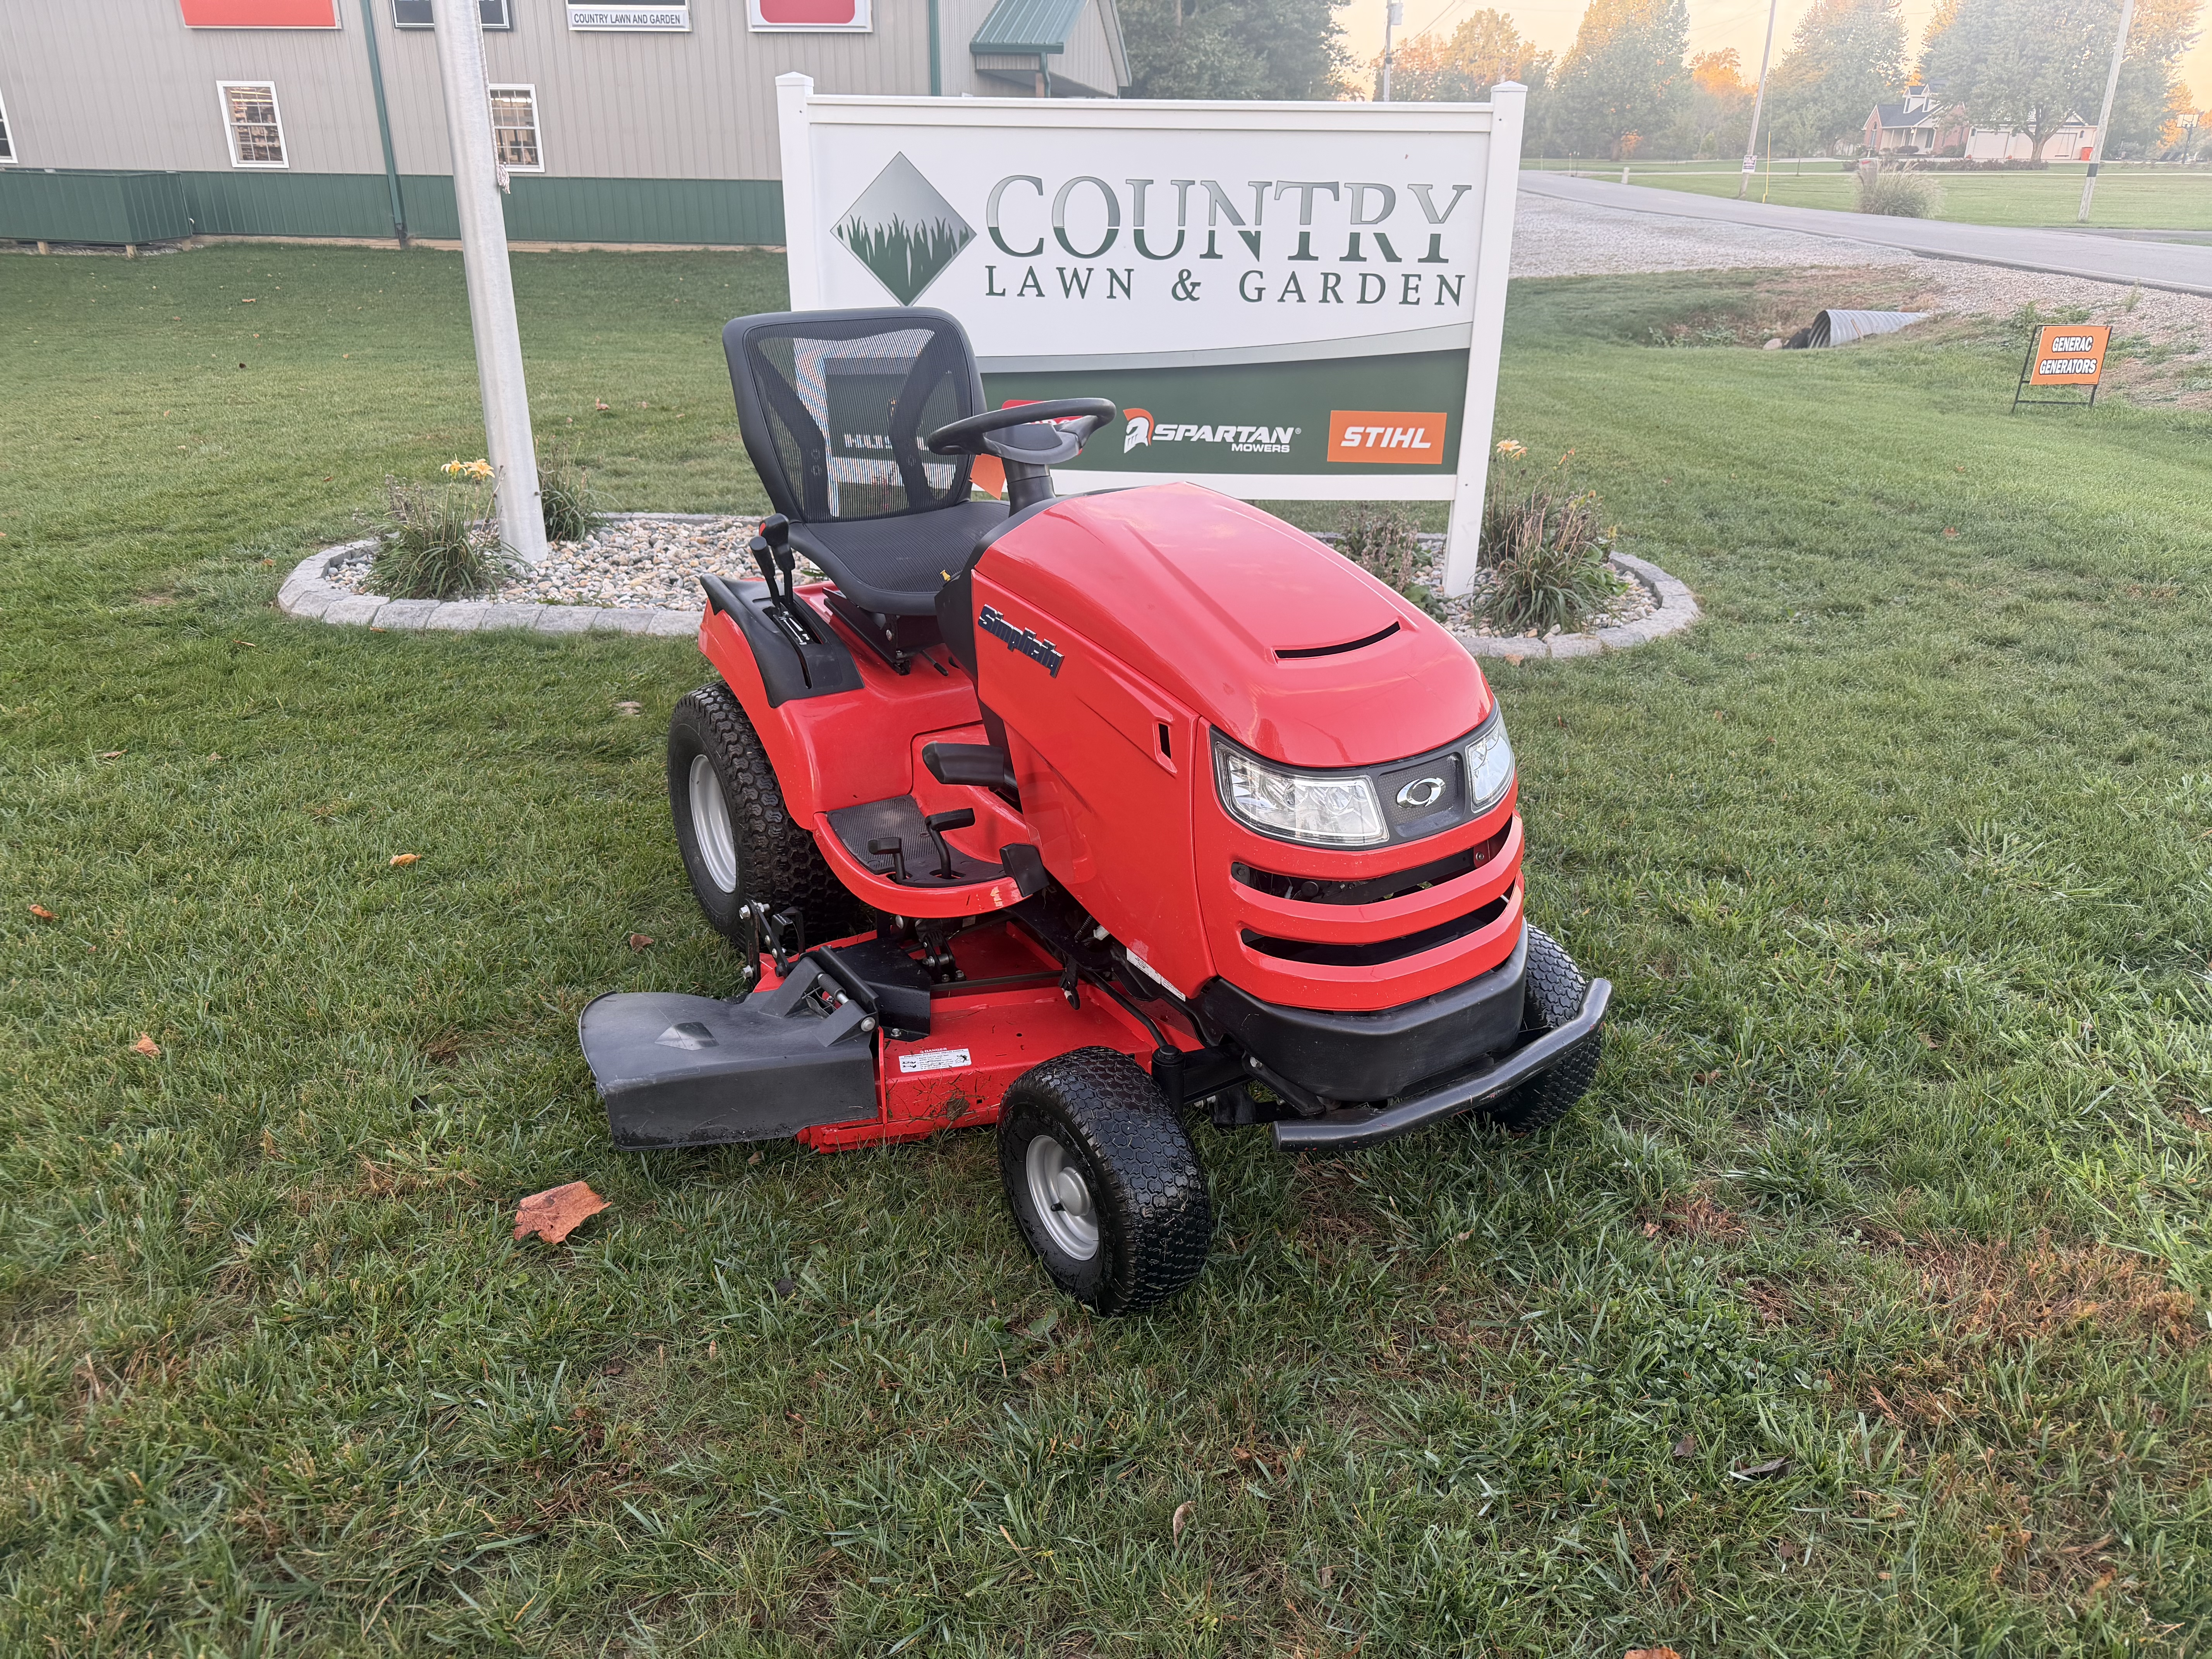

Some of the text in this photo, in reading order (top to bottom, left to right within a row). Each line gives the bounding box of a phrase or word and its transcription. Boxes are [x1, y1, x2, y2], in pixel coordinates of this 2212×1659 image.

[574, 14, 680, 24] COUNTRY LAWN AND GARDEN
[986, 175, 1472, 263] COUNTRY
[985, 265, 1466, 307] LAWN & GARDEN
[2052, 336, 2094, 352] GENERAC
[2039, 358, 2097, 374] GENERATORS
[1152, 424, 1295, 444] SPARTAN
[1340, 426, 1431, 448] STIHL
[1231, 443, 1290, 453] MOWERS
[978, 604, 1065, 678] Simplicity
